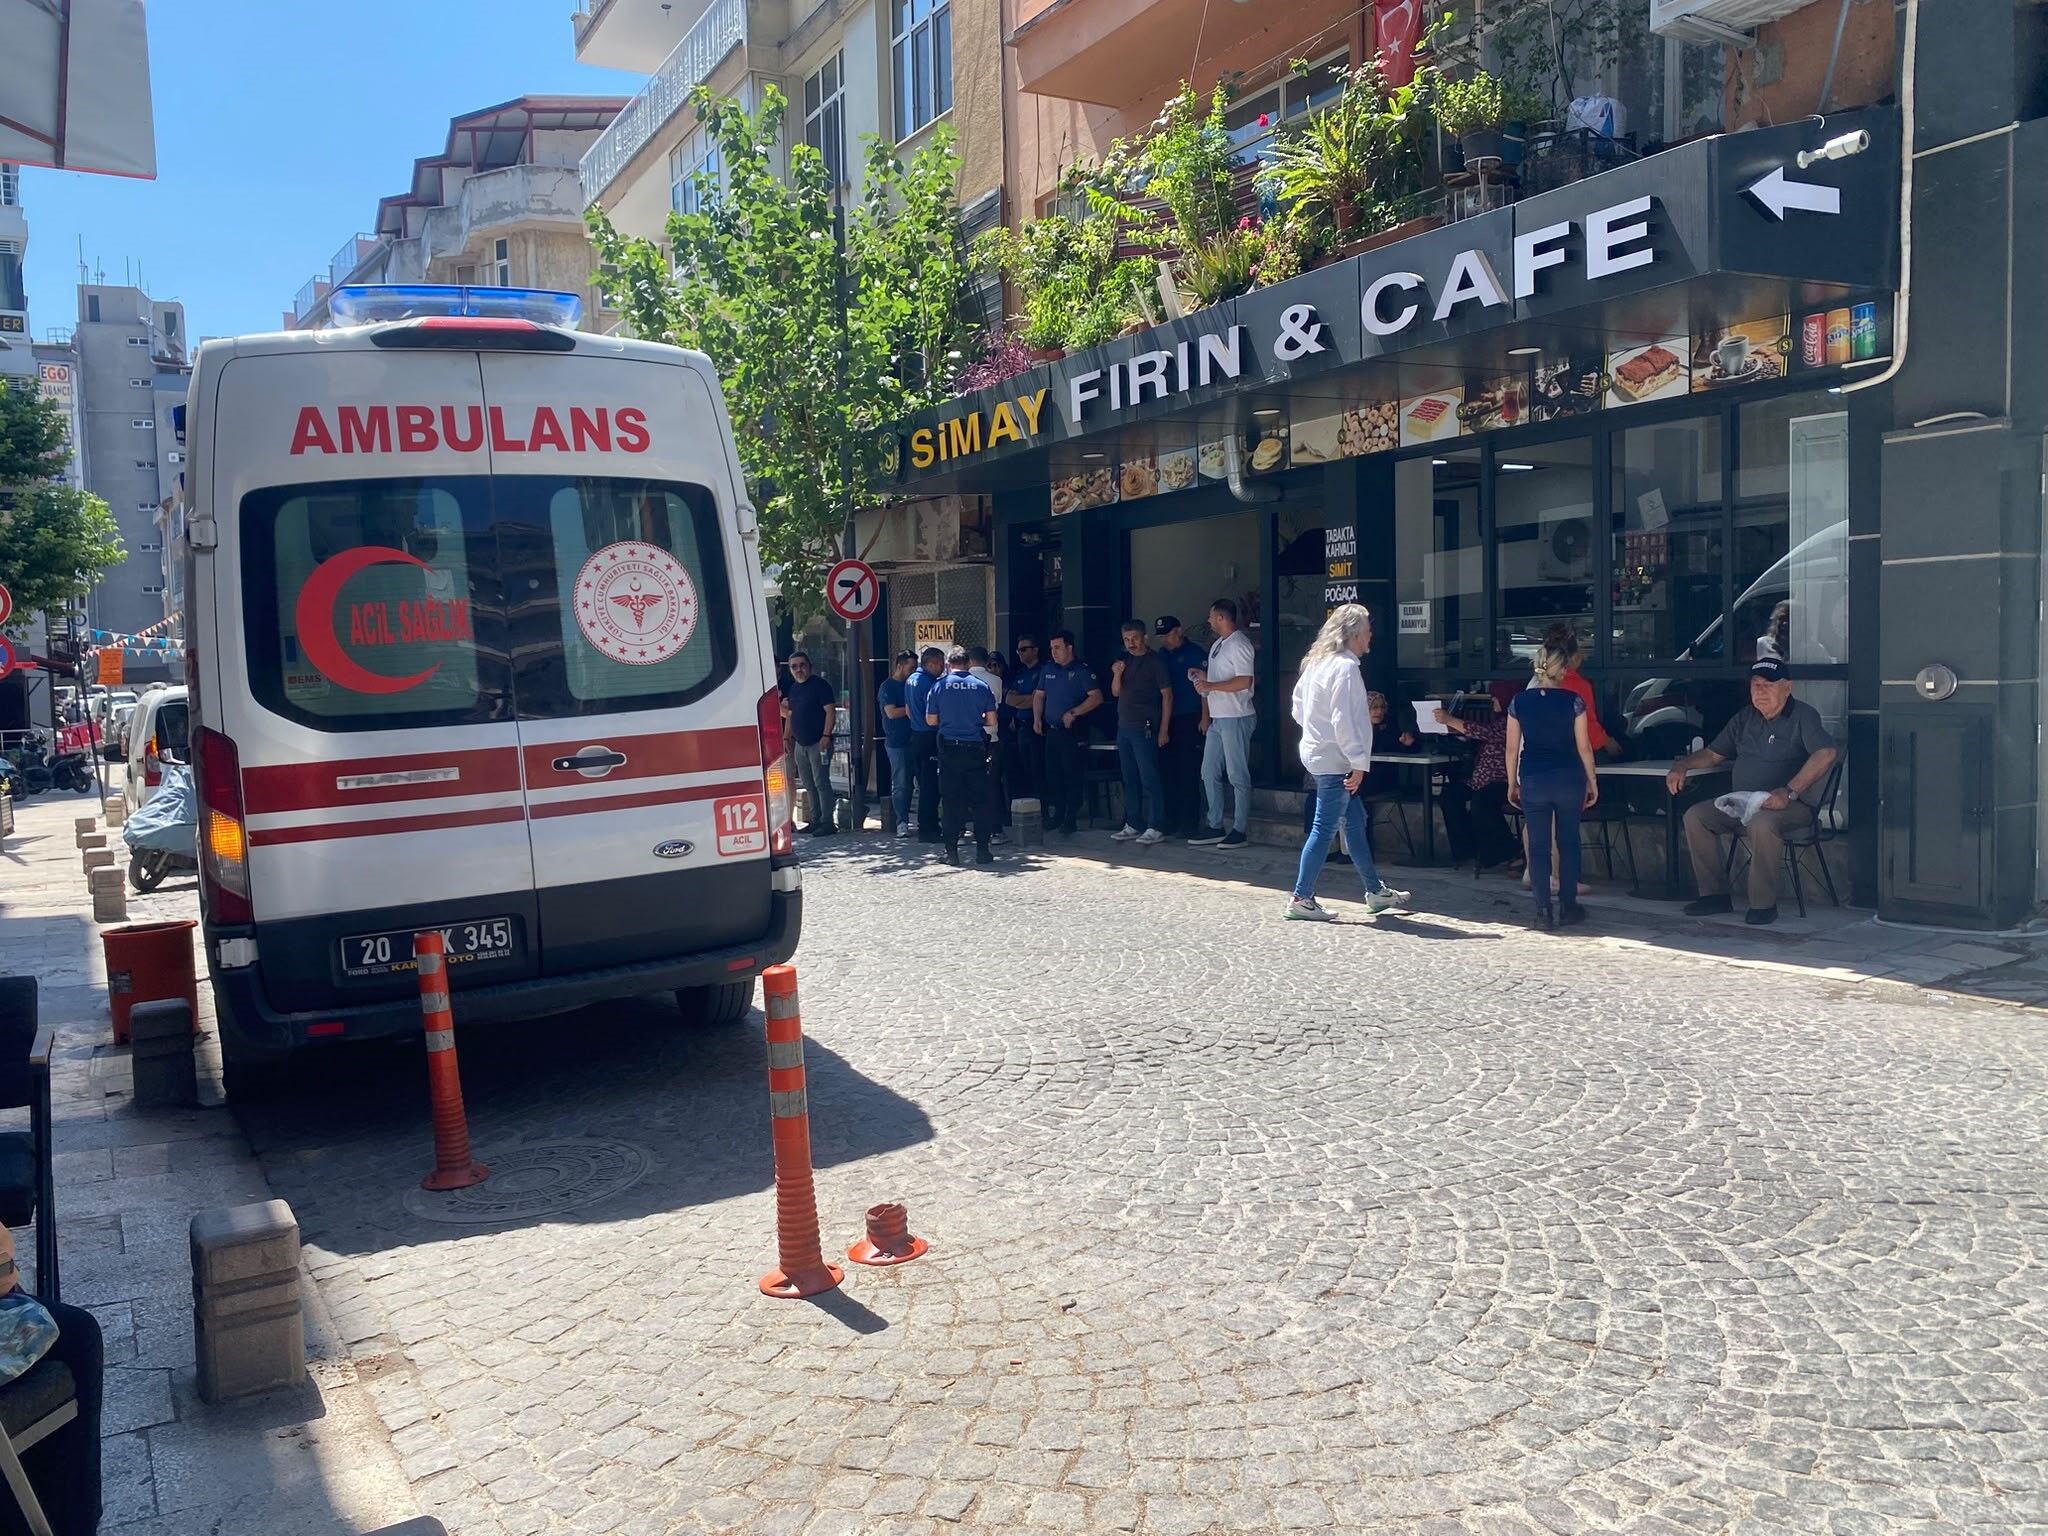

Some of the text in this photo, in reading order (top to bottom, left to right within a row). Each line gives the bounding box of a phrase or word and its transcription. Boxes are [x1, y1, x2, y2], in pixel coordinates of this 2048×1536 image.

[1070, 324, 1247, 423] FIRIN
[1273, 303, 1329, 361] &
[1361, 195, 1656, 336] CAFE
[41, 366, 67, 380] EGO
[290, 404, 651, 456] AMBULANS
[1325, 525, 1355, 543] TABAKTA
[1325, 541, 1357, 558] KAHVALTI
[918, 624, 953, 640] SATILIK
[722, 802, 759, 831] 112
[662, 844, 686, 855] Ford
[360, 937, 391, 965] 20
[464, 922, 509, 950] 345
[448, 953, 474, 964] OTO
